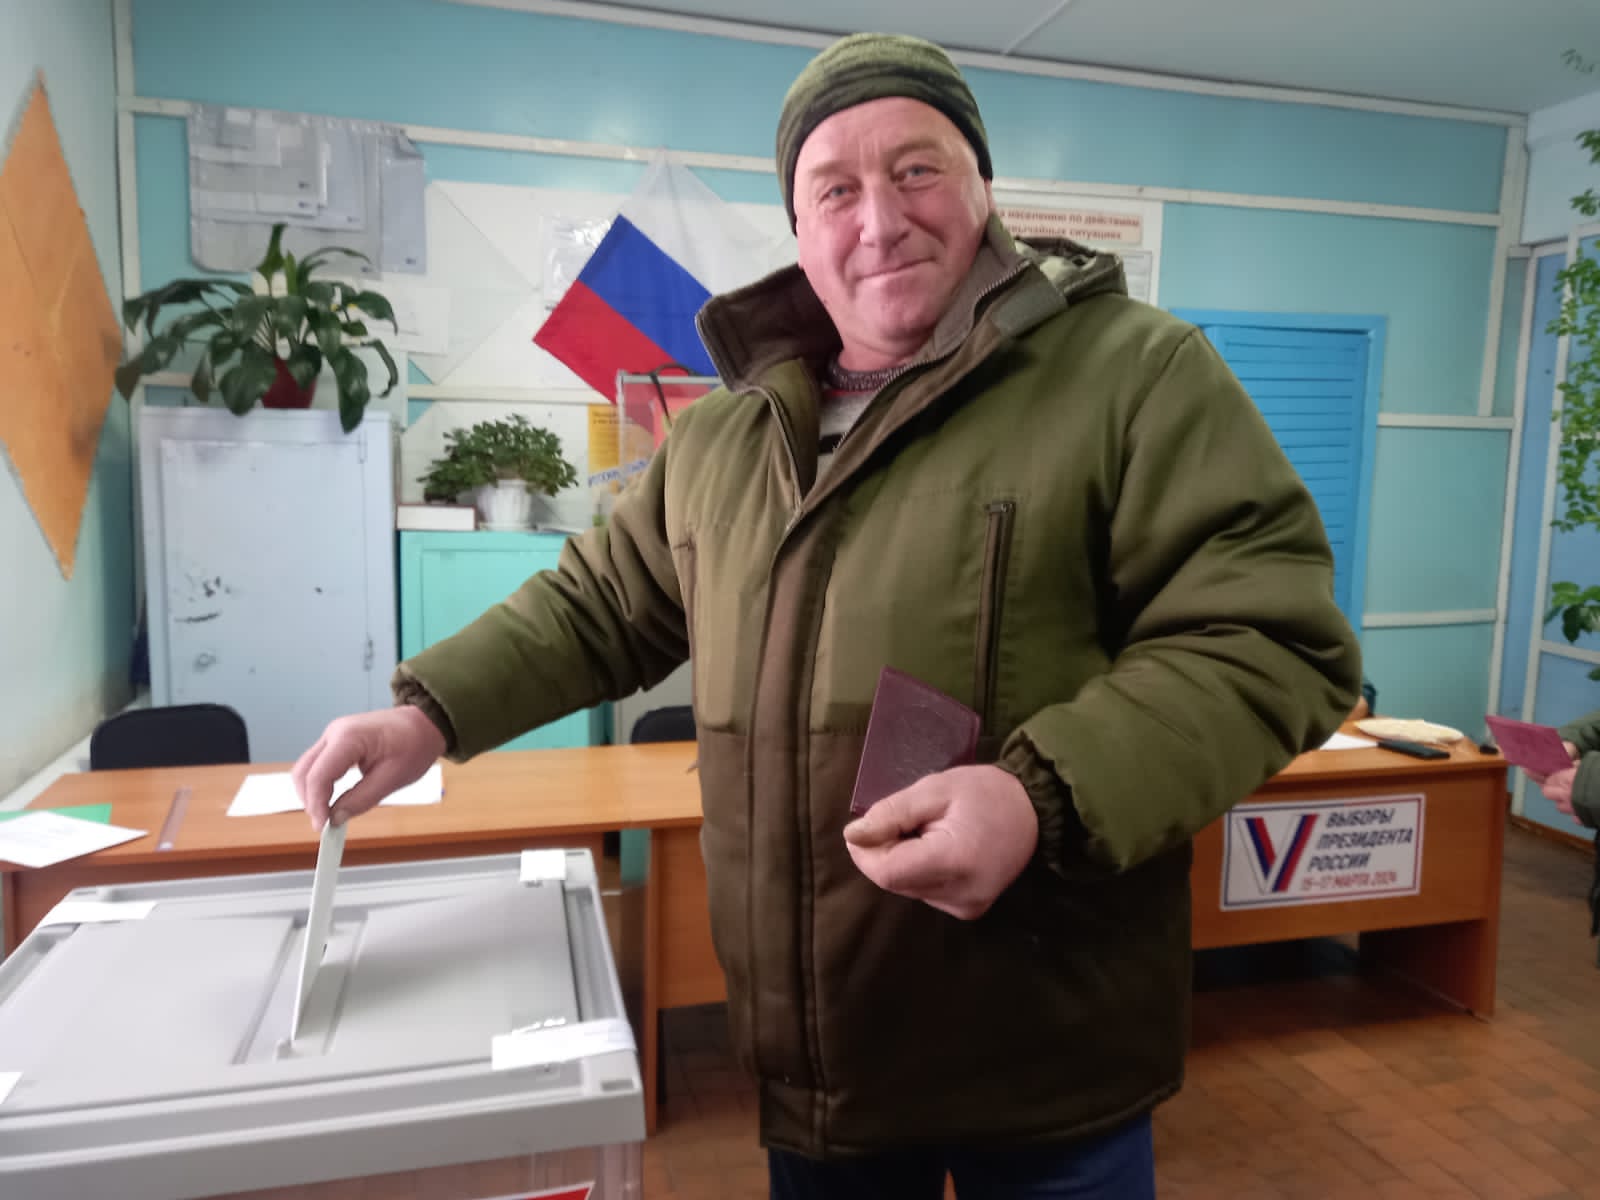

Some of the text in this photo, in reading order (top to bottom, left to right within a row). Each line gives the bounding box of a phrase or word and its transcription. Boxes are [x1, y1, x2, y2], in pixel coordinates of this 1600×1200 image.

[1326, 808, 1395, 828] ВЫБОРЫ
[1317, 828, 1413, 849] ПРЕЗИДЕНТА
[1307, 852, 1371, 872] РОССИИ
